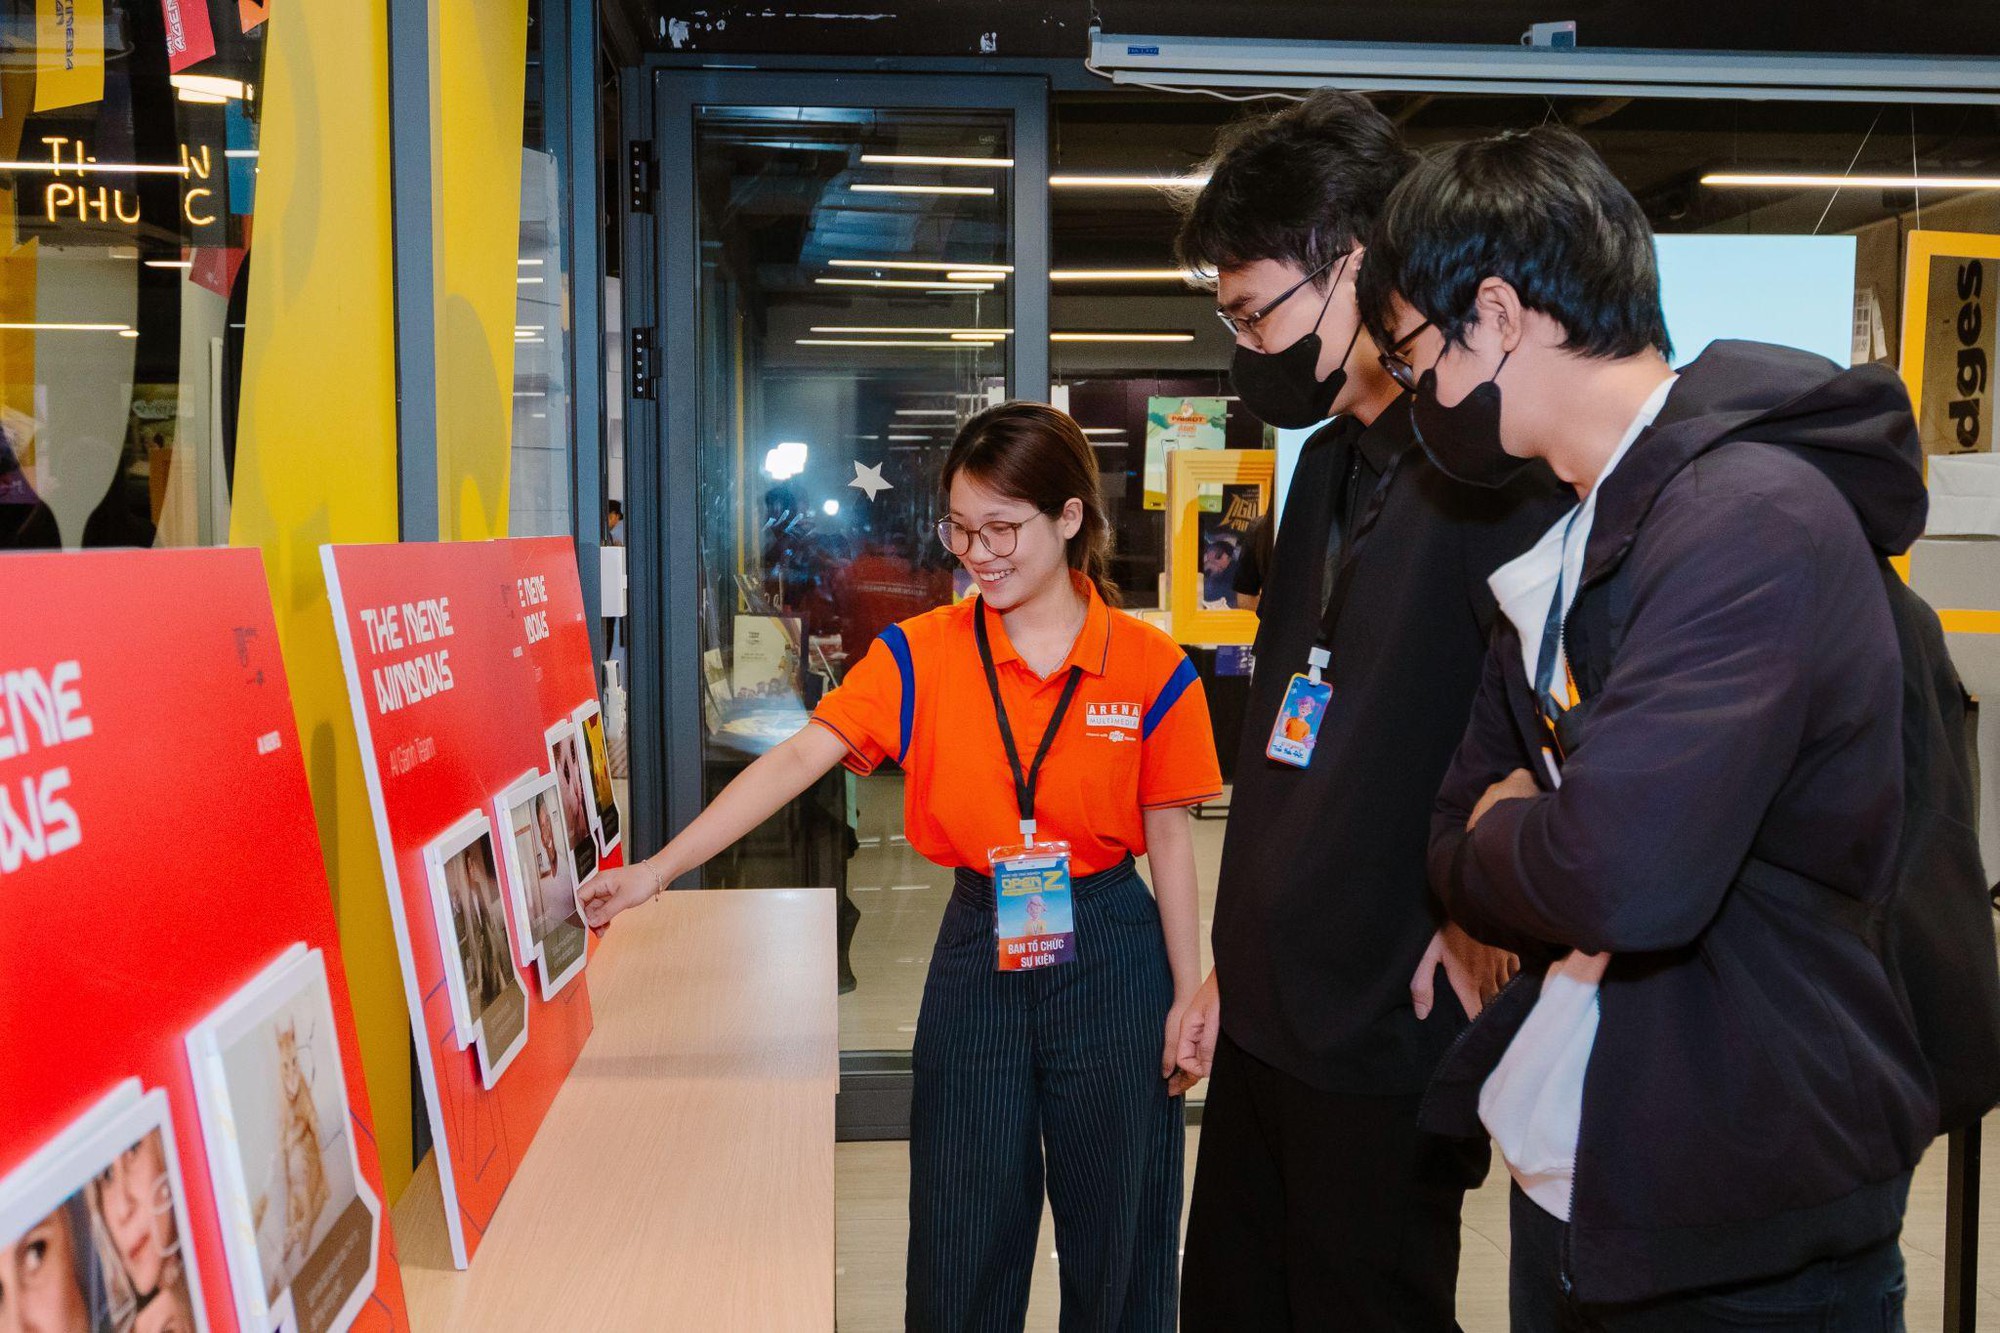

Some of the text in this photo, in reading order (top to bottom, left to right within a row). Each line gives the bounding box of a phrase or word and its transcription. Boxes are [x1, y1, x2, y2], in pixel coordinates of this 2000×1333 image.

[46, 184, 216, 225] PHUC
[1948, 259, 1987, 455] dges
[360, 605, 404, 655] THE
[372, 649, 455, 715] WINDOWS
[1088, 704, 1139, 717] ARENA
[1089, 716, 1138, 727] MULTIMEDIA
[1008, 942, 1025, 954] BAN
[1040, 938, 1065, 951] CHỨC
[1021, 953, 1055, 968] SỰ KIỆN
